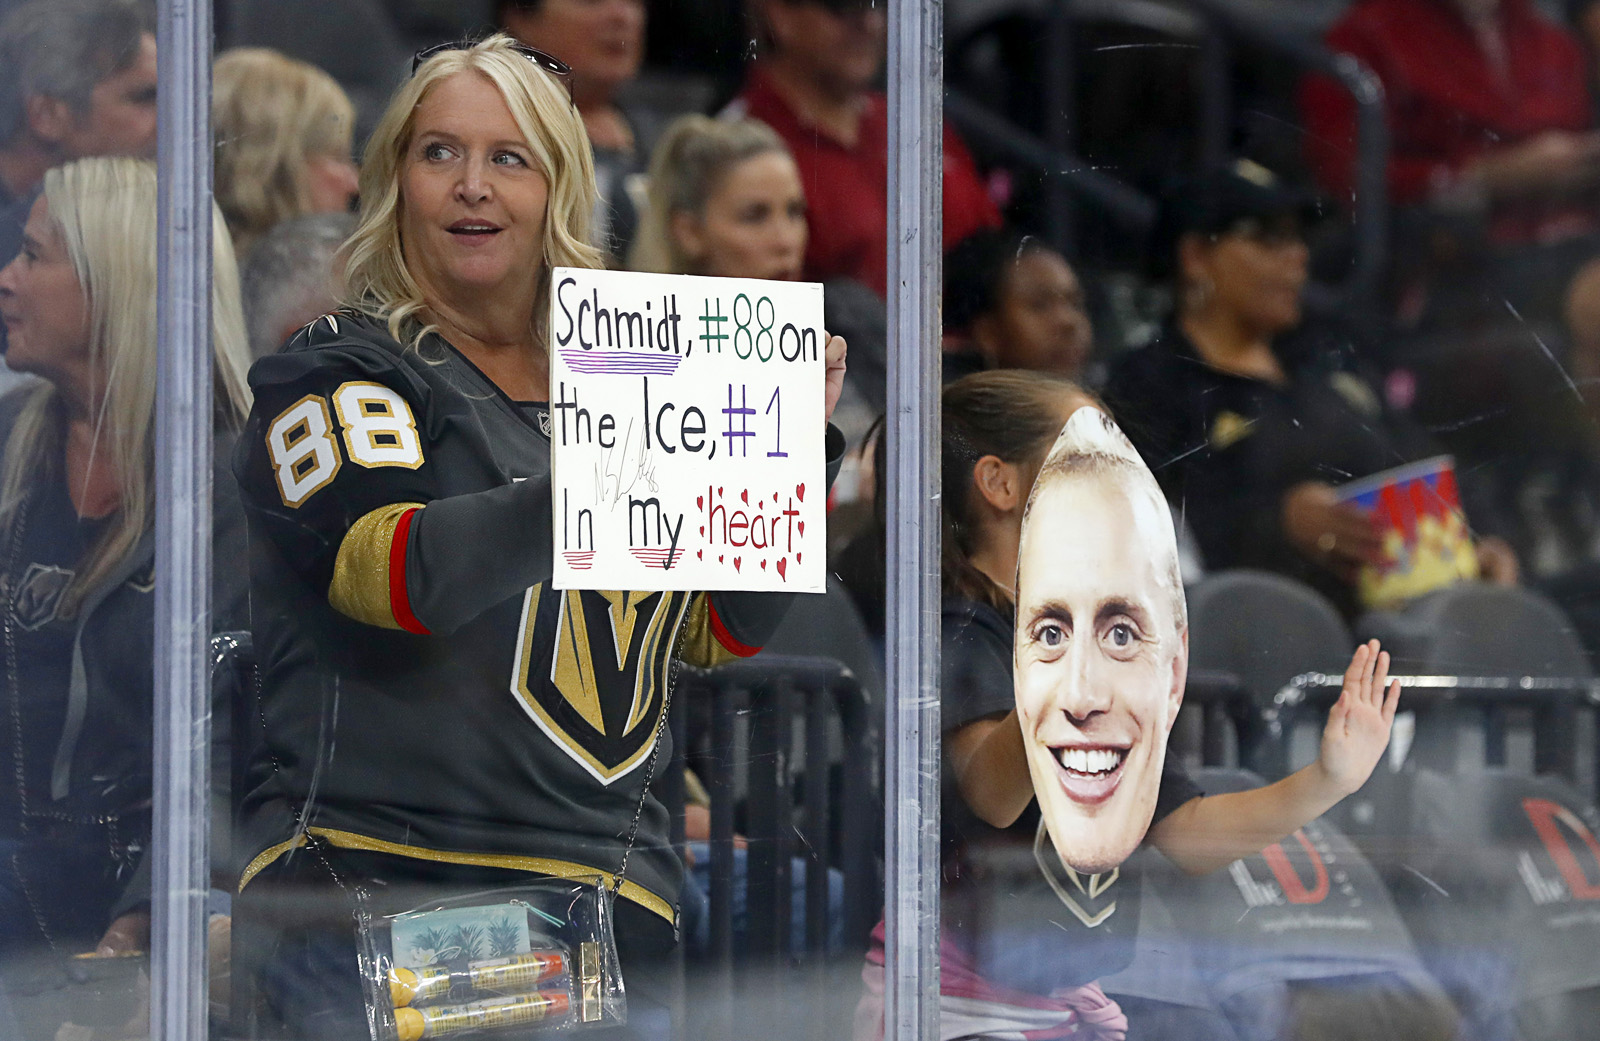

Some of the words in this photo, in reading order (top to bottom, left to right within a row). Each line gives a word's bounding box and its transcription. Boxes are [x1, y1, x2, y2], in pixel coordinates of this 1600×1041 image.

[556, 277, 692, 358] Schmidt,
[698, 293, 775, 363] #88
[779, 322, 818, 363] on
[265, 380, 425, 509] 88
[554, 381, 616, 449] the
[643, 375, 716, 461] Ice,
[721, 383, 789, 458] #1
[563, 487, 594, 552] In
[628, 494, 684, 571] my
[708, 485, 800, 553] heart
